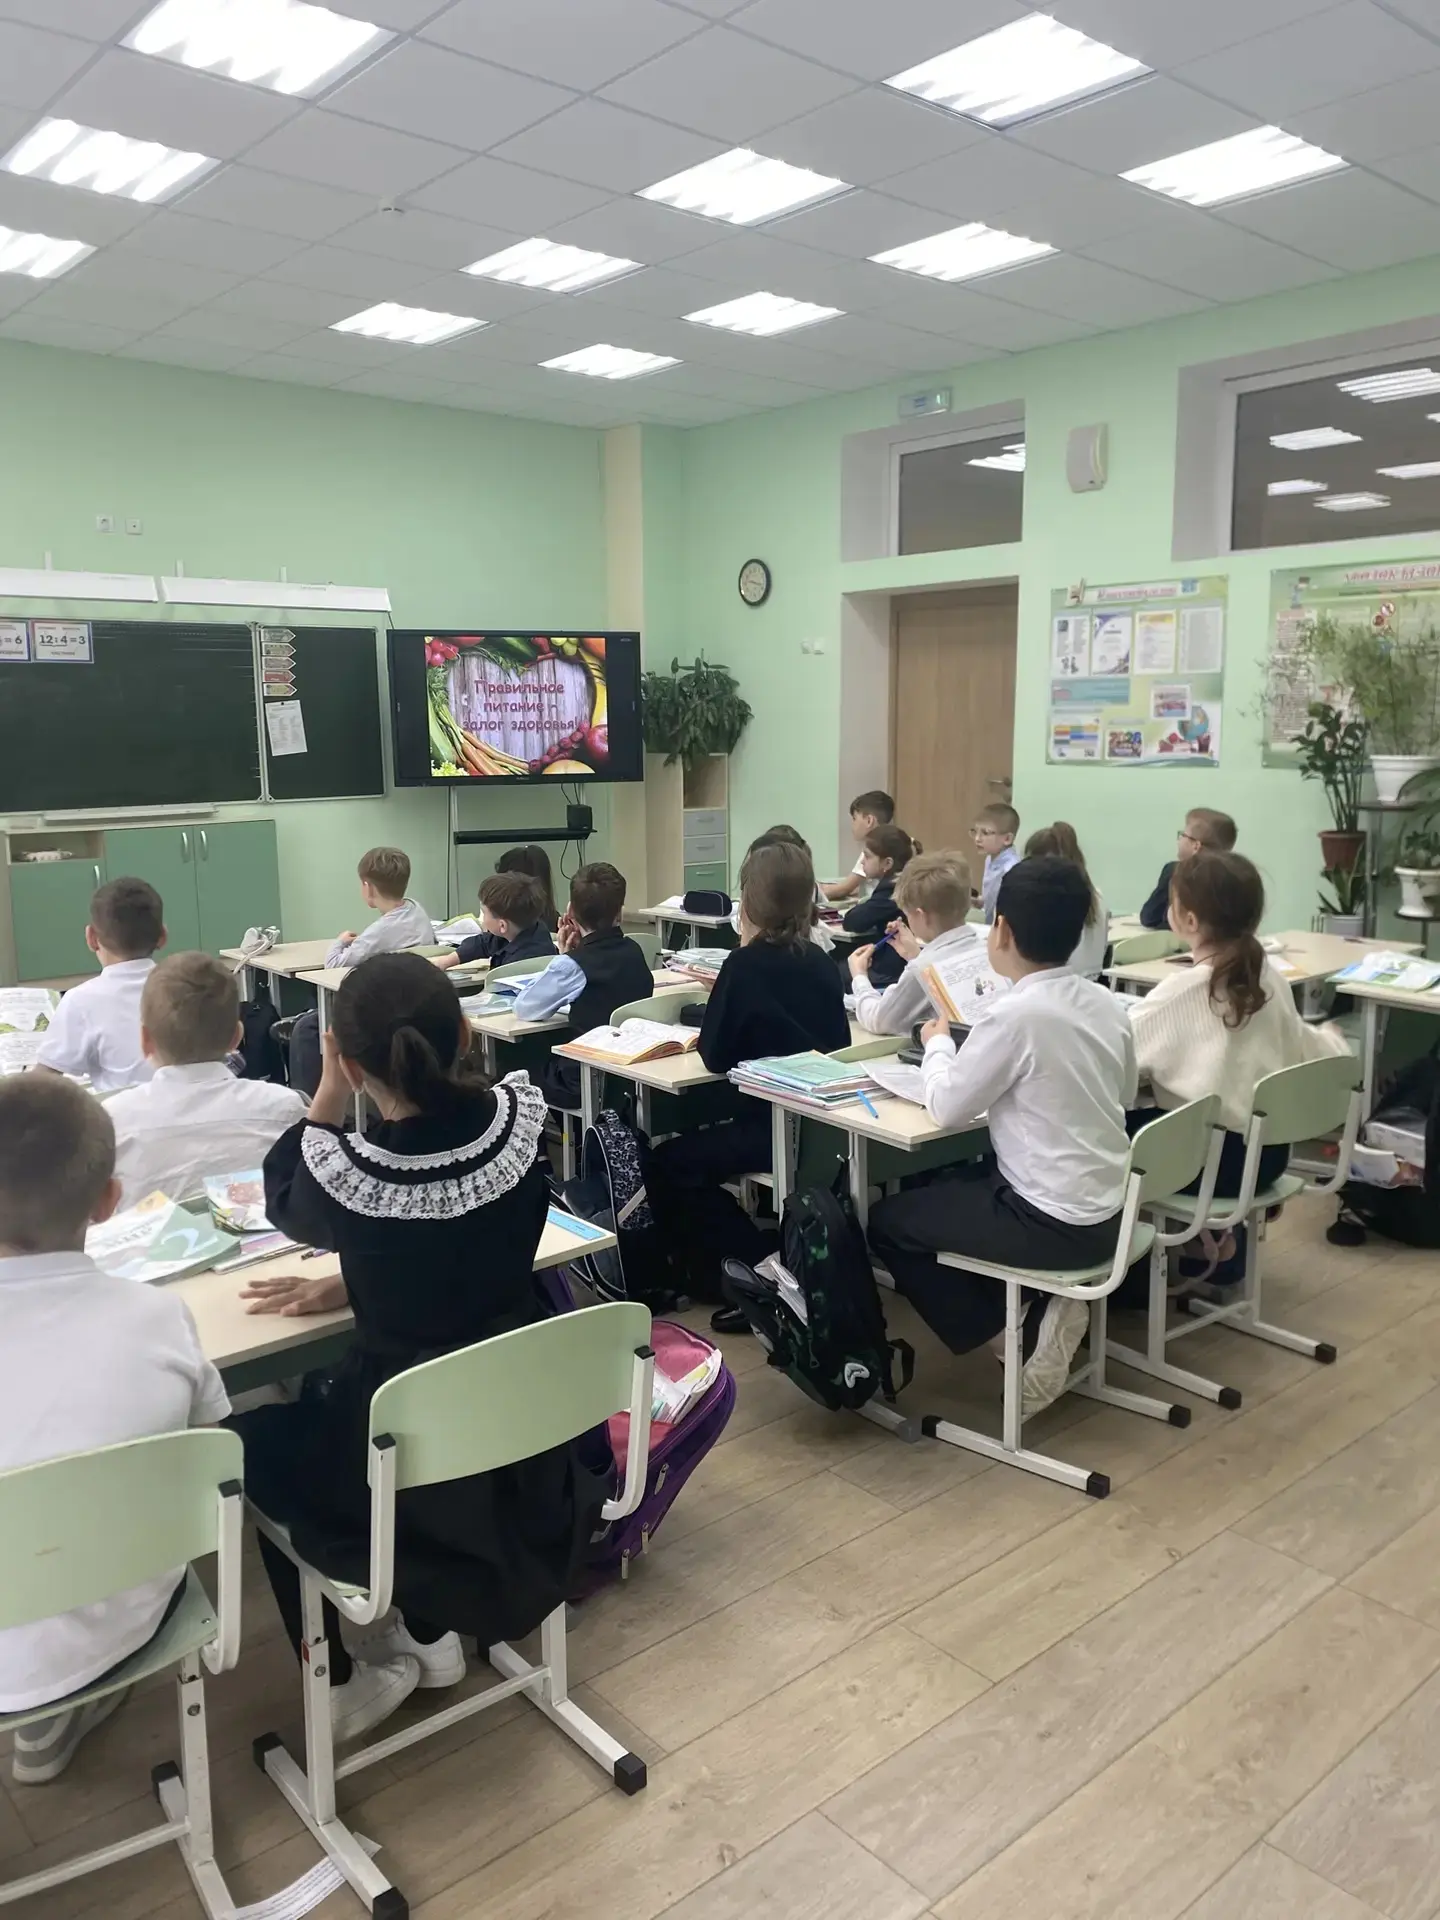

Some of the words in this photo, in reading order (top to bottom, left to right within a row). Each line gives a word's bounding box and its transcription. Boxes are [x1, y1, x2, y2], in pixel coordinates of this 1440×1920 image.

[474, 680, 565, 697] Правильное
[483, 701, 545, 713] питание
[463, 719, 505, 732] залог
[511, 716, 579, 733] здоровья!
